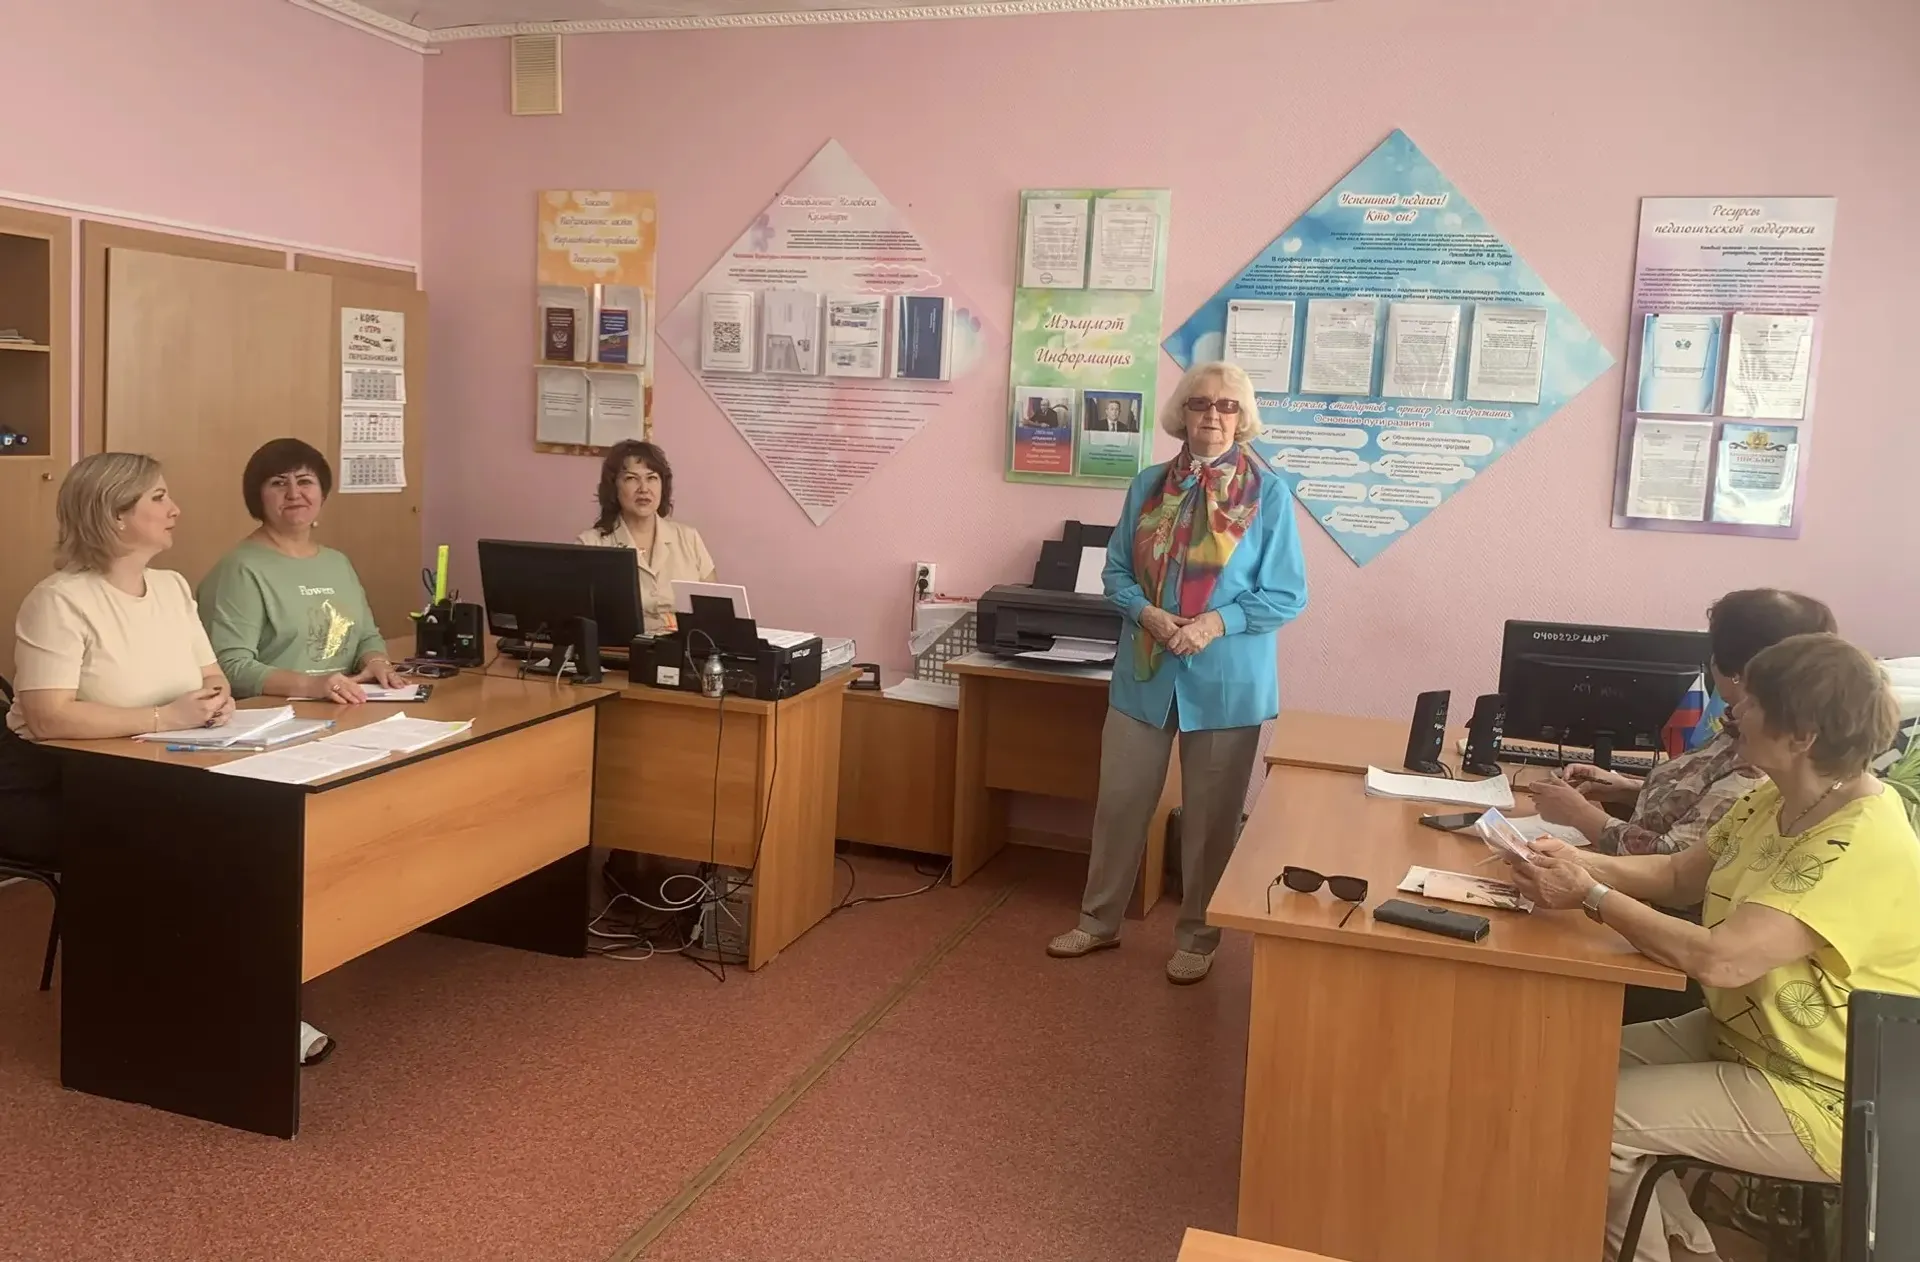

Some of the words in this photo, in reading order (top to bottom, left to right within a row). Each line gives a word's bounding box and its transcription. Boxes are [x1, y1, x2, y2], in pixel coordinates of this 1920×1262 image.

[1341, 193, 1396, 205] Успешный
[1401, 193, 1447, 206] педагог!
[1366, 210, 1390, 221] Кто
[1395, 211, 1417, 221] он?
[1711, 204, 1761, 221] Ресурсы
[1653, 221, 1745, 234] педагогической
[1749, 221, 1816, 238] поддержки
[1037, 348, 1131, 369] Информация
[1281, 398, 1289, 407] в
[1291, 400, 1326, 411] зеркале
[1330, 400, 1386, 414] стандартов
[1397, 406, 1432, 417] пример
[1436, 405, 1451, 414] для
[1456, 408, 1512, 419] подражания
[1315, 414, 1361, 424] Основные
[1364, 417, 1385, 426] пути
[1387, 420, 1431, 428] развития
[298, 585, 335, 596] Flowers
